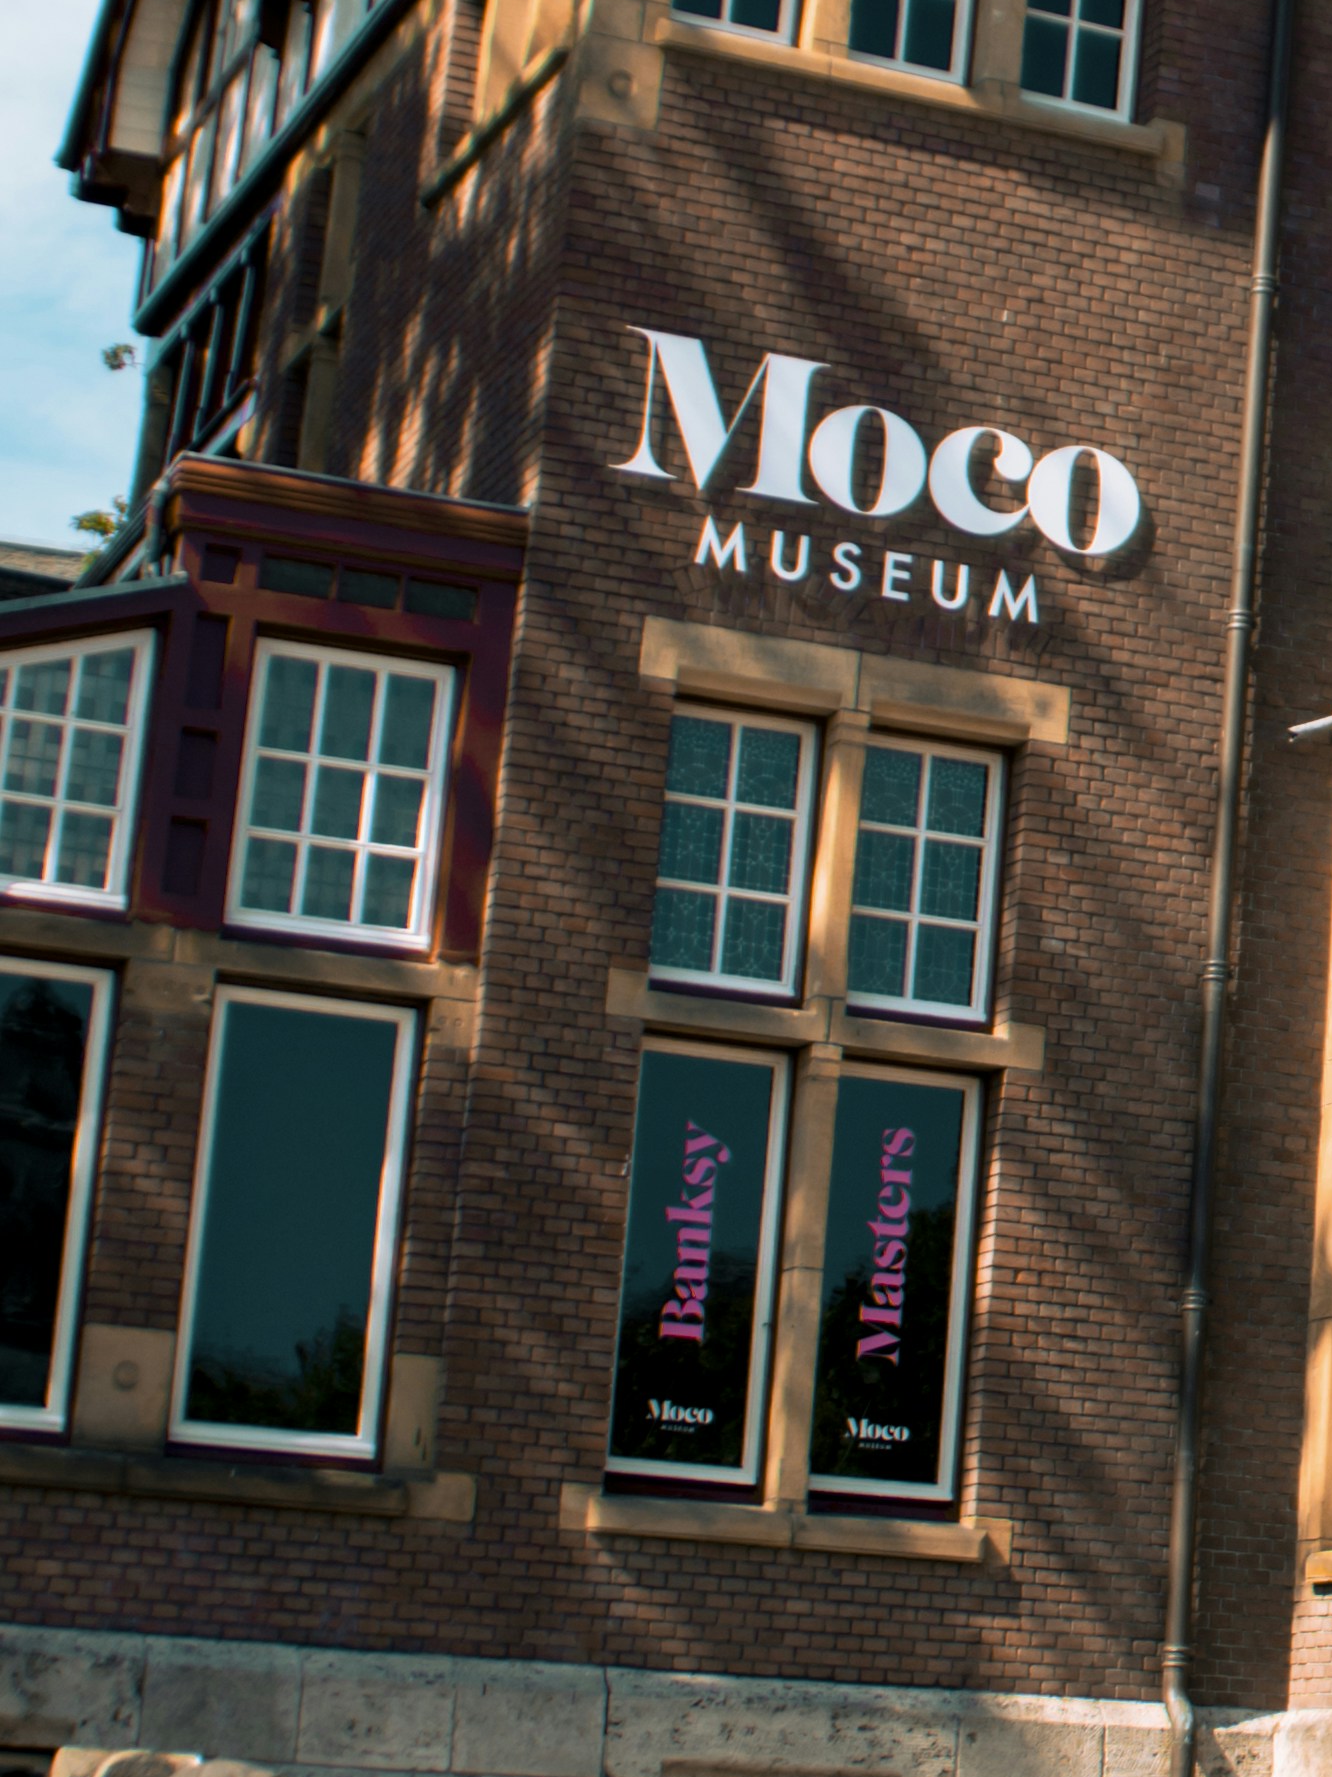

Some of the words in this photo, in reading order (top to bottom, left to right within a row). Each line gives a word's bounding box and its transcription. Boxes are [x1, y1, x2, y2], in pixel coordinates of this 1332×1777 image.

[608, 325, 1140, 555] Moco
[694, 514, 1039, 624] MUSEUM
[659, 1120, 731, 1343] Banksy
[856, 1127, 916, 1367] Masters
[646, 1398, 714, 1425] Moco
[845, 1417, 910, 1442] Moco
